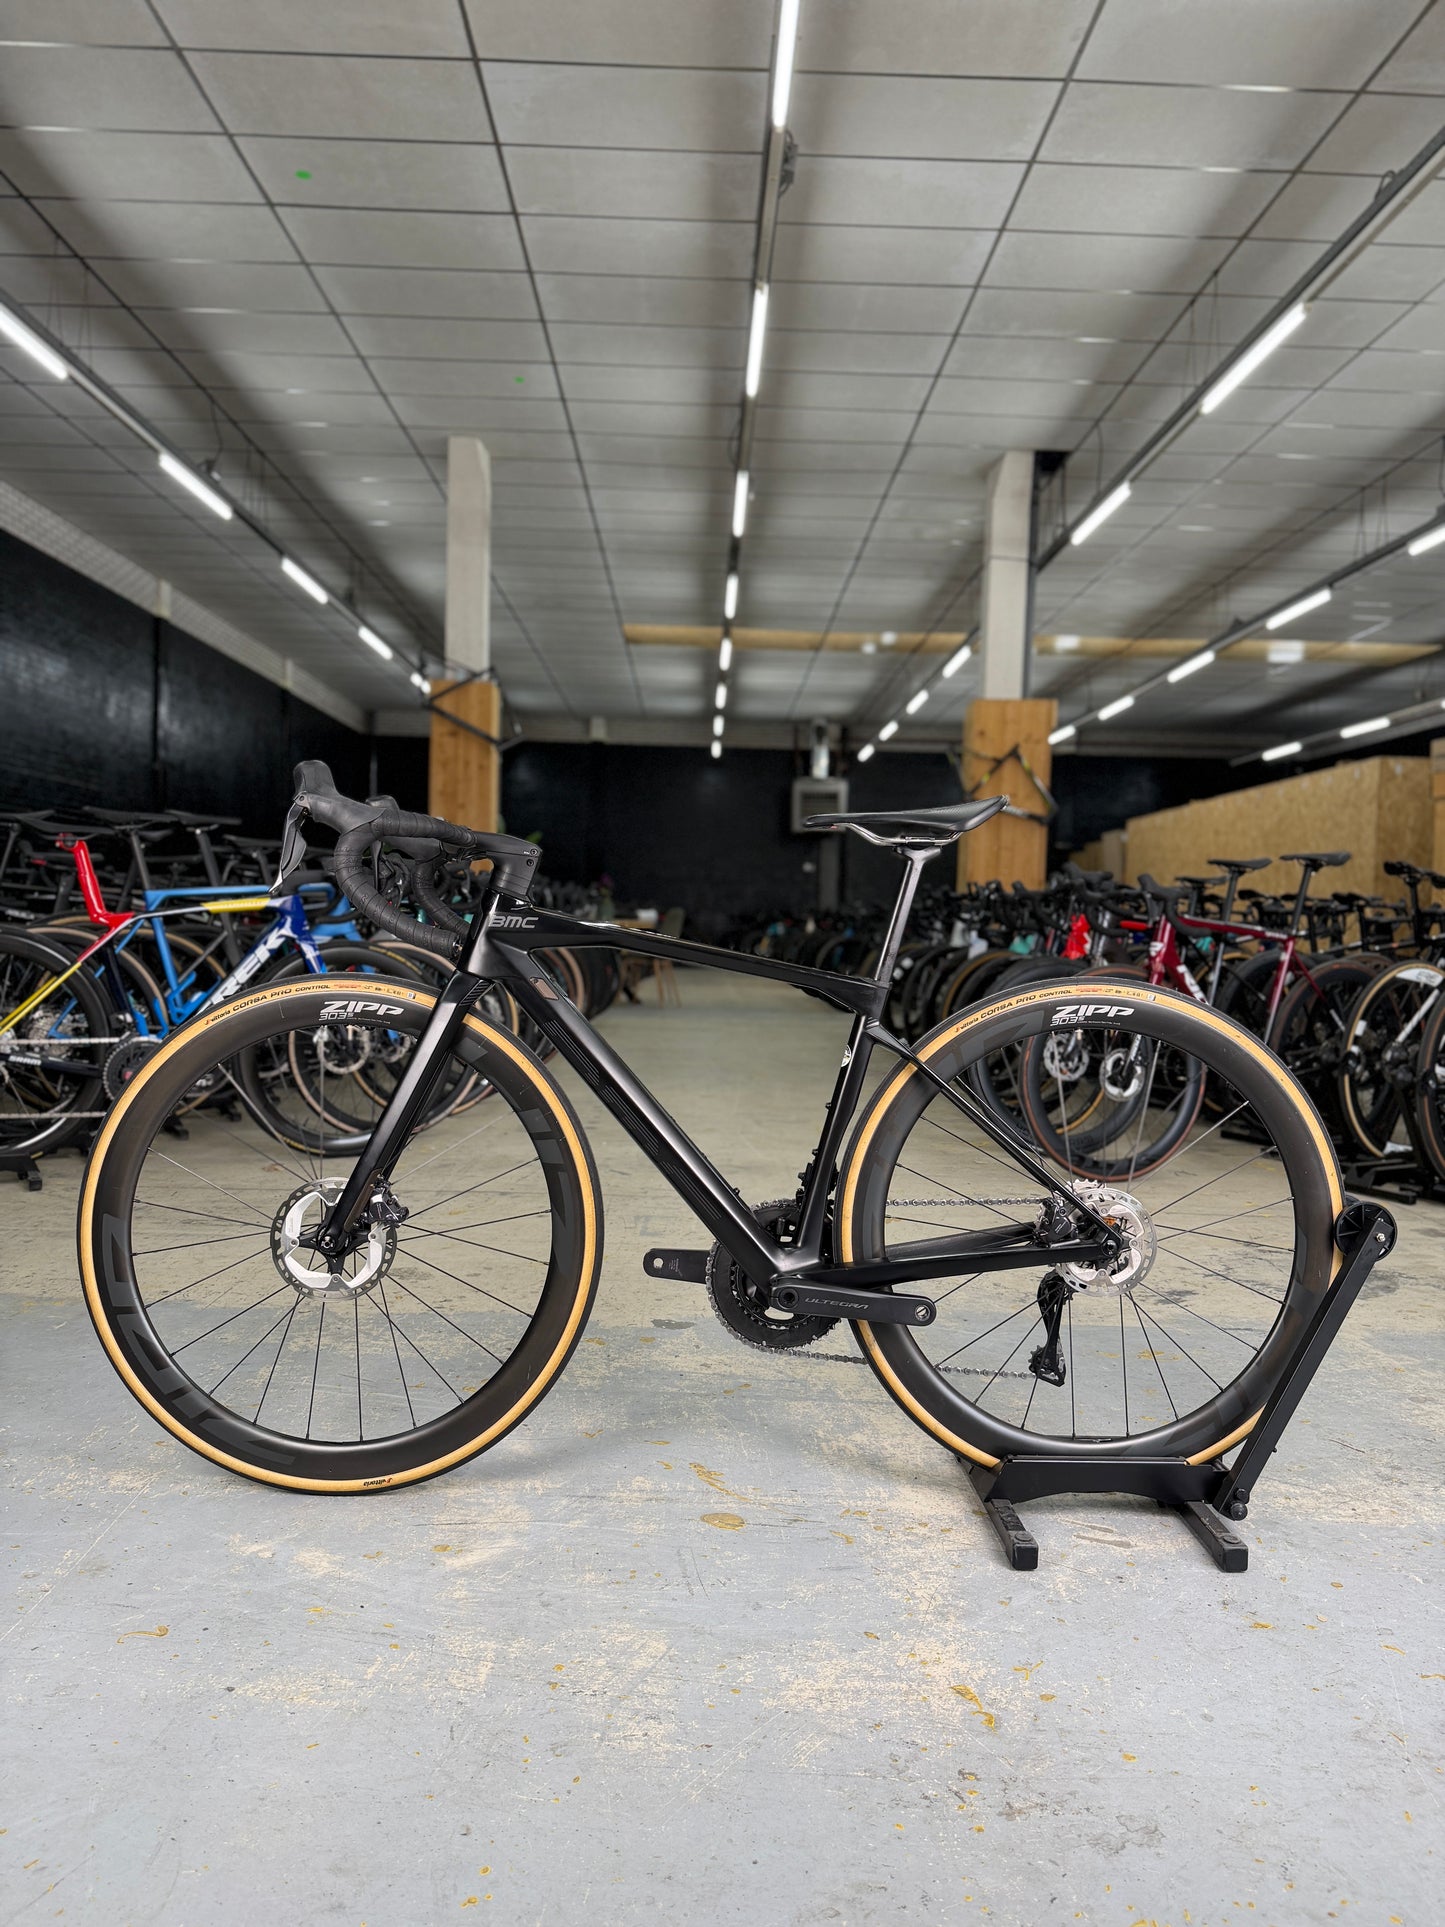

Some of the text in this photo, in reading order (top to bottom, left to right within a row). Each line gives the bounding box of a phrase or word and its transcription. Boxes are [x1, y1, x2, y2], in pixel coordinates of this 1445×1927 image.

[488, 915, 539, 928] BMC
[196, 926, 286, 1016] REK
[232, 994, 268, 1012] CORSA
[270, 988, 292, 998] PRO
[295, 984, 331, 992] CONTROL
[981, 1001, 1013, 1019] CORSA
[1016, 994, 1037, 1005] PRO
[1039, 989, 1073, 998] CONTROL
[320, 1000, 404, 1016] ZIPP
[1052, 1004, 1135, 1019] ZIPP
[804, 1297, 870, 1310] ULTEGRA
